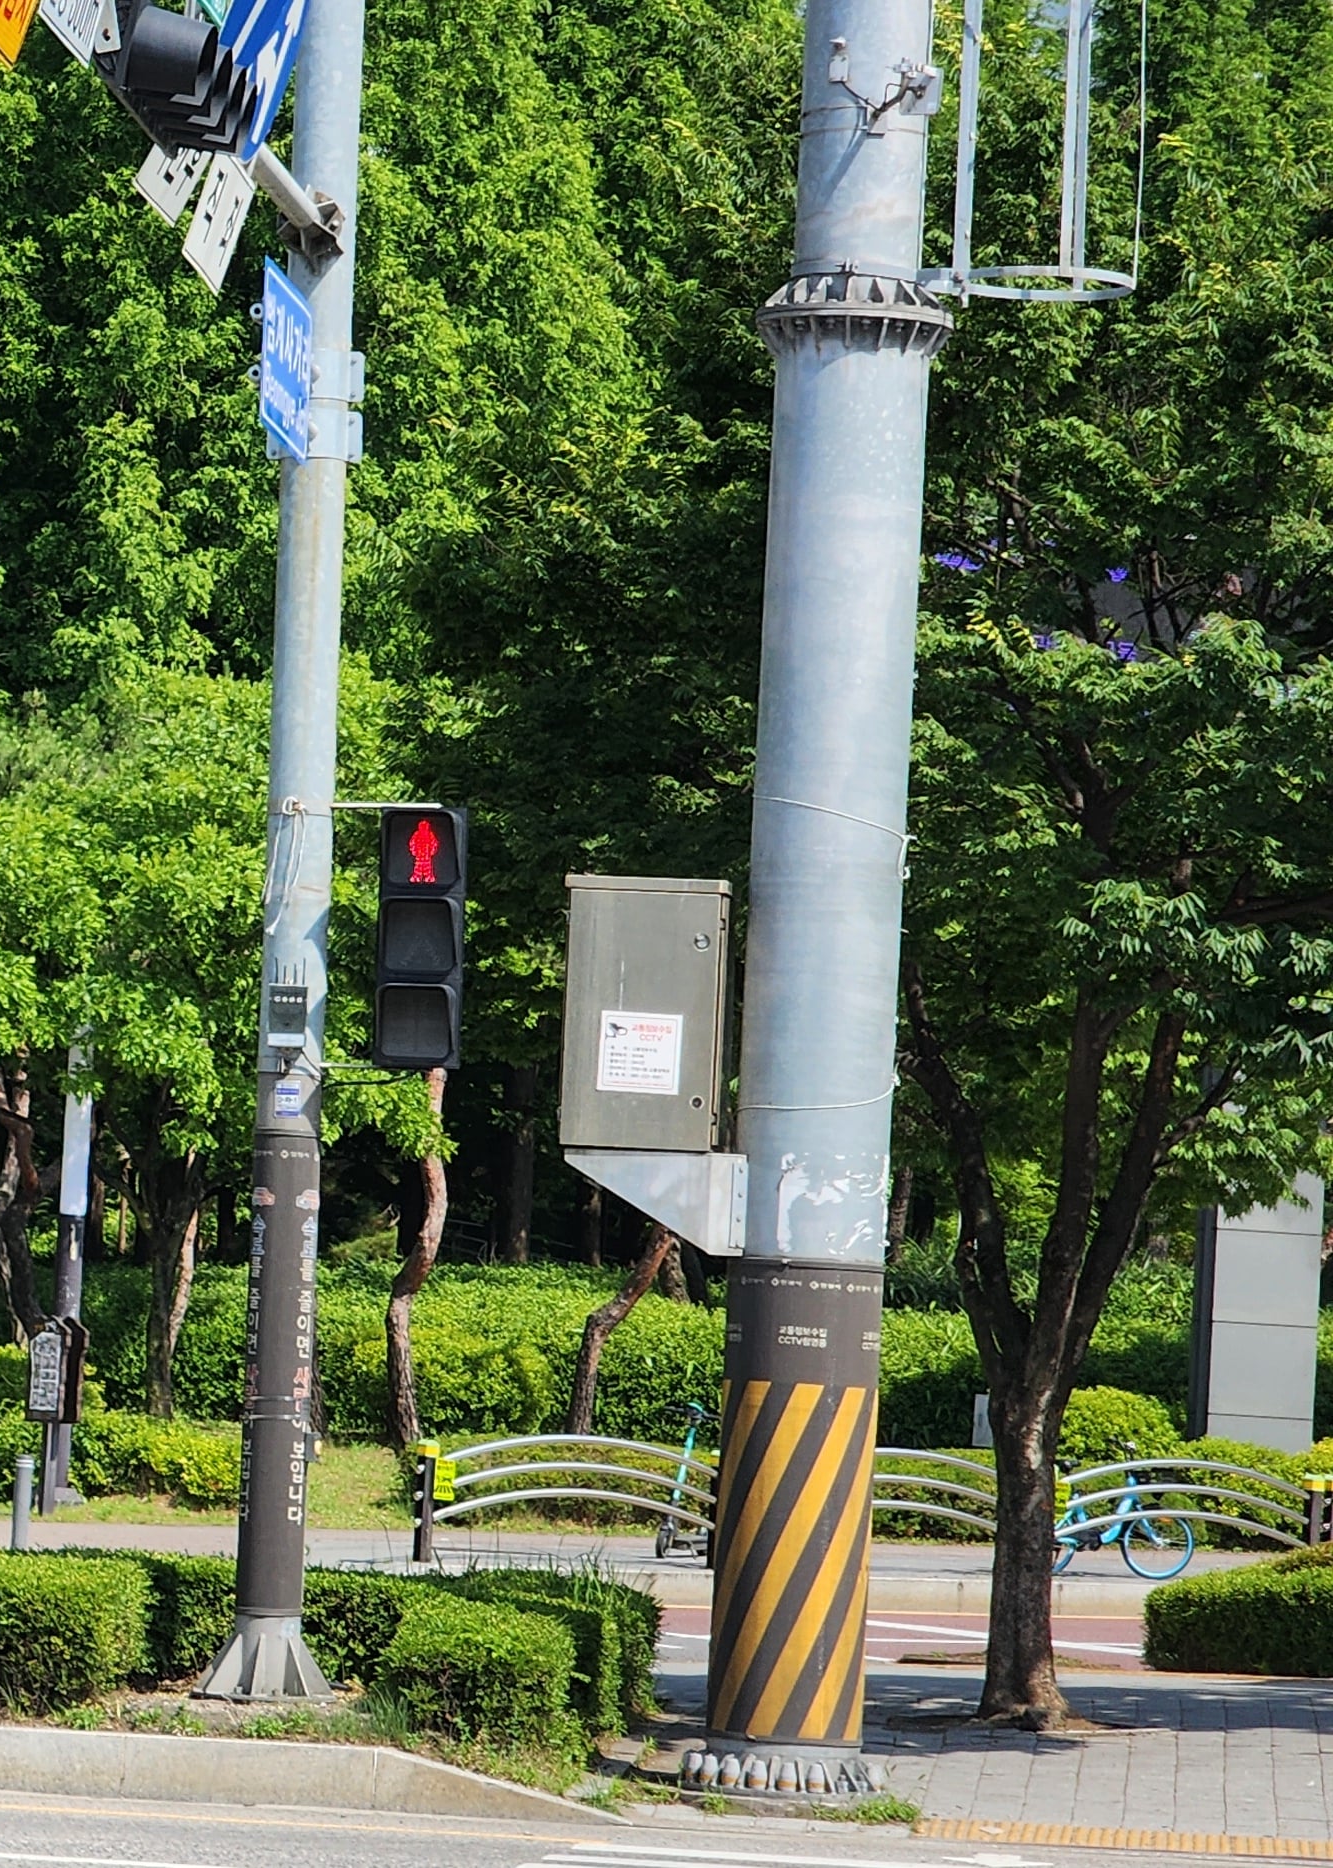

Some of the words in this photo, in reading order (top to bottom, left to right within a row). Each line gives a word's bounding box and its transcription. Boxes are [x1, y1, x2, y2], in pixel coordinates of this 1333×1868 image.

[639, 1034, 663, 1042] CCTV
[300, 1216, 317, 1282] 속도를
[295, 1289, 313, 1359] 줄이면
[287, 1441, 305, 1526] 보입니다
